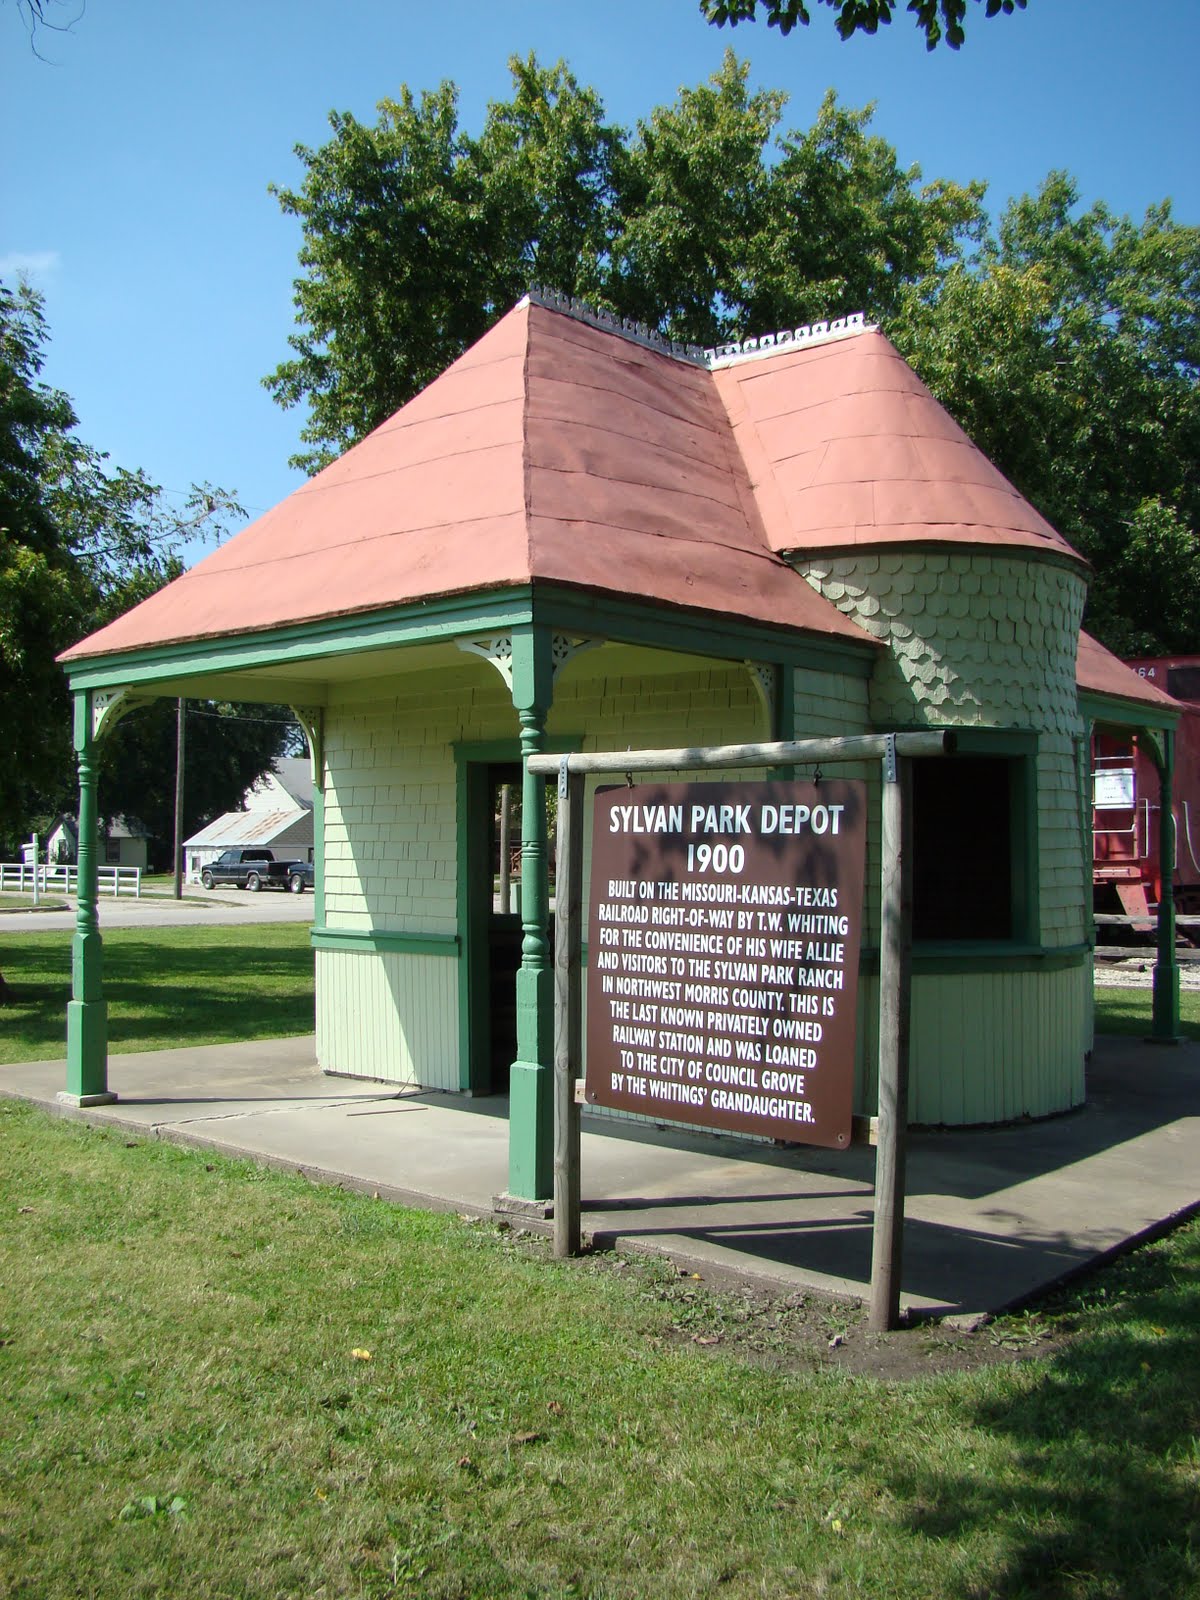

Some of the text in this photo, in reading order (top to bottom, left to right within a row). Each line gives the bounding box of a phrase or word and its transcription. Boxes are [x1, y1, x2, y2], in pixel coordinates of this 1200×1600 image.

[609, 805, 844, 834] SYLVAN PARK DEPOT
[687, 844, 745, 873] 1900
[608, 880, 837, 907] BUILT ON THE MISSOURI-KANSAS-TEXAS
[598, 904, 848, 935] RAILROAD RIGHT-OF-WAY BY T.W. WHITING
[600, 928, 844, 961] FOR THE CONVENIENCE OF HIS WIFE ALLIE
[598, 952, 843, 989] AND VISITORS TO THE SYLVAN PARK RANCH
[602, 976, 834, 1016] IN NORTHWEST MORRIS COUNTY. THIS IS
[610, 1001, 822, 1041] THE LAST KNOWN PRIVATELY OWNED
[613, 1025, 817, 1068] RAILWAY STATION AND WAS LOANED
[621, 1051, 804, 1094] TO THE CITY OF COUNCIL GROVE
[611, 1073, 624, 1090] BY
[626, 1075, 646, 1095] THE
[711, 1090, 816, 1123] GRANDAUGHTER.
